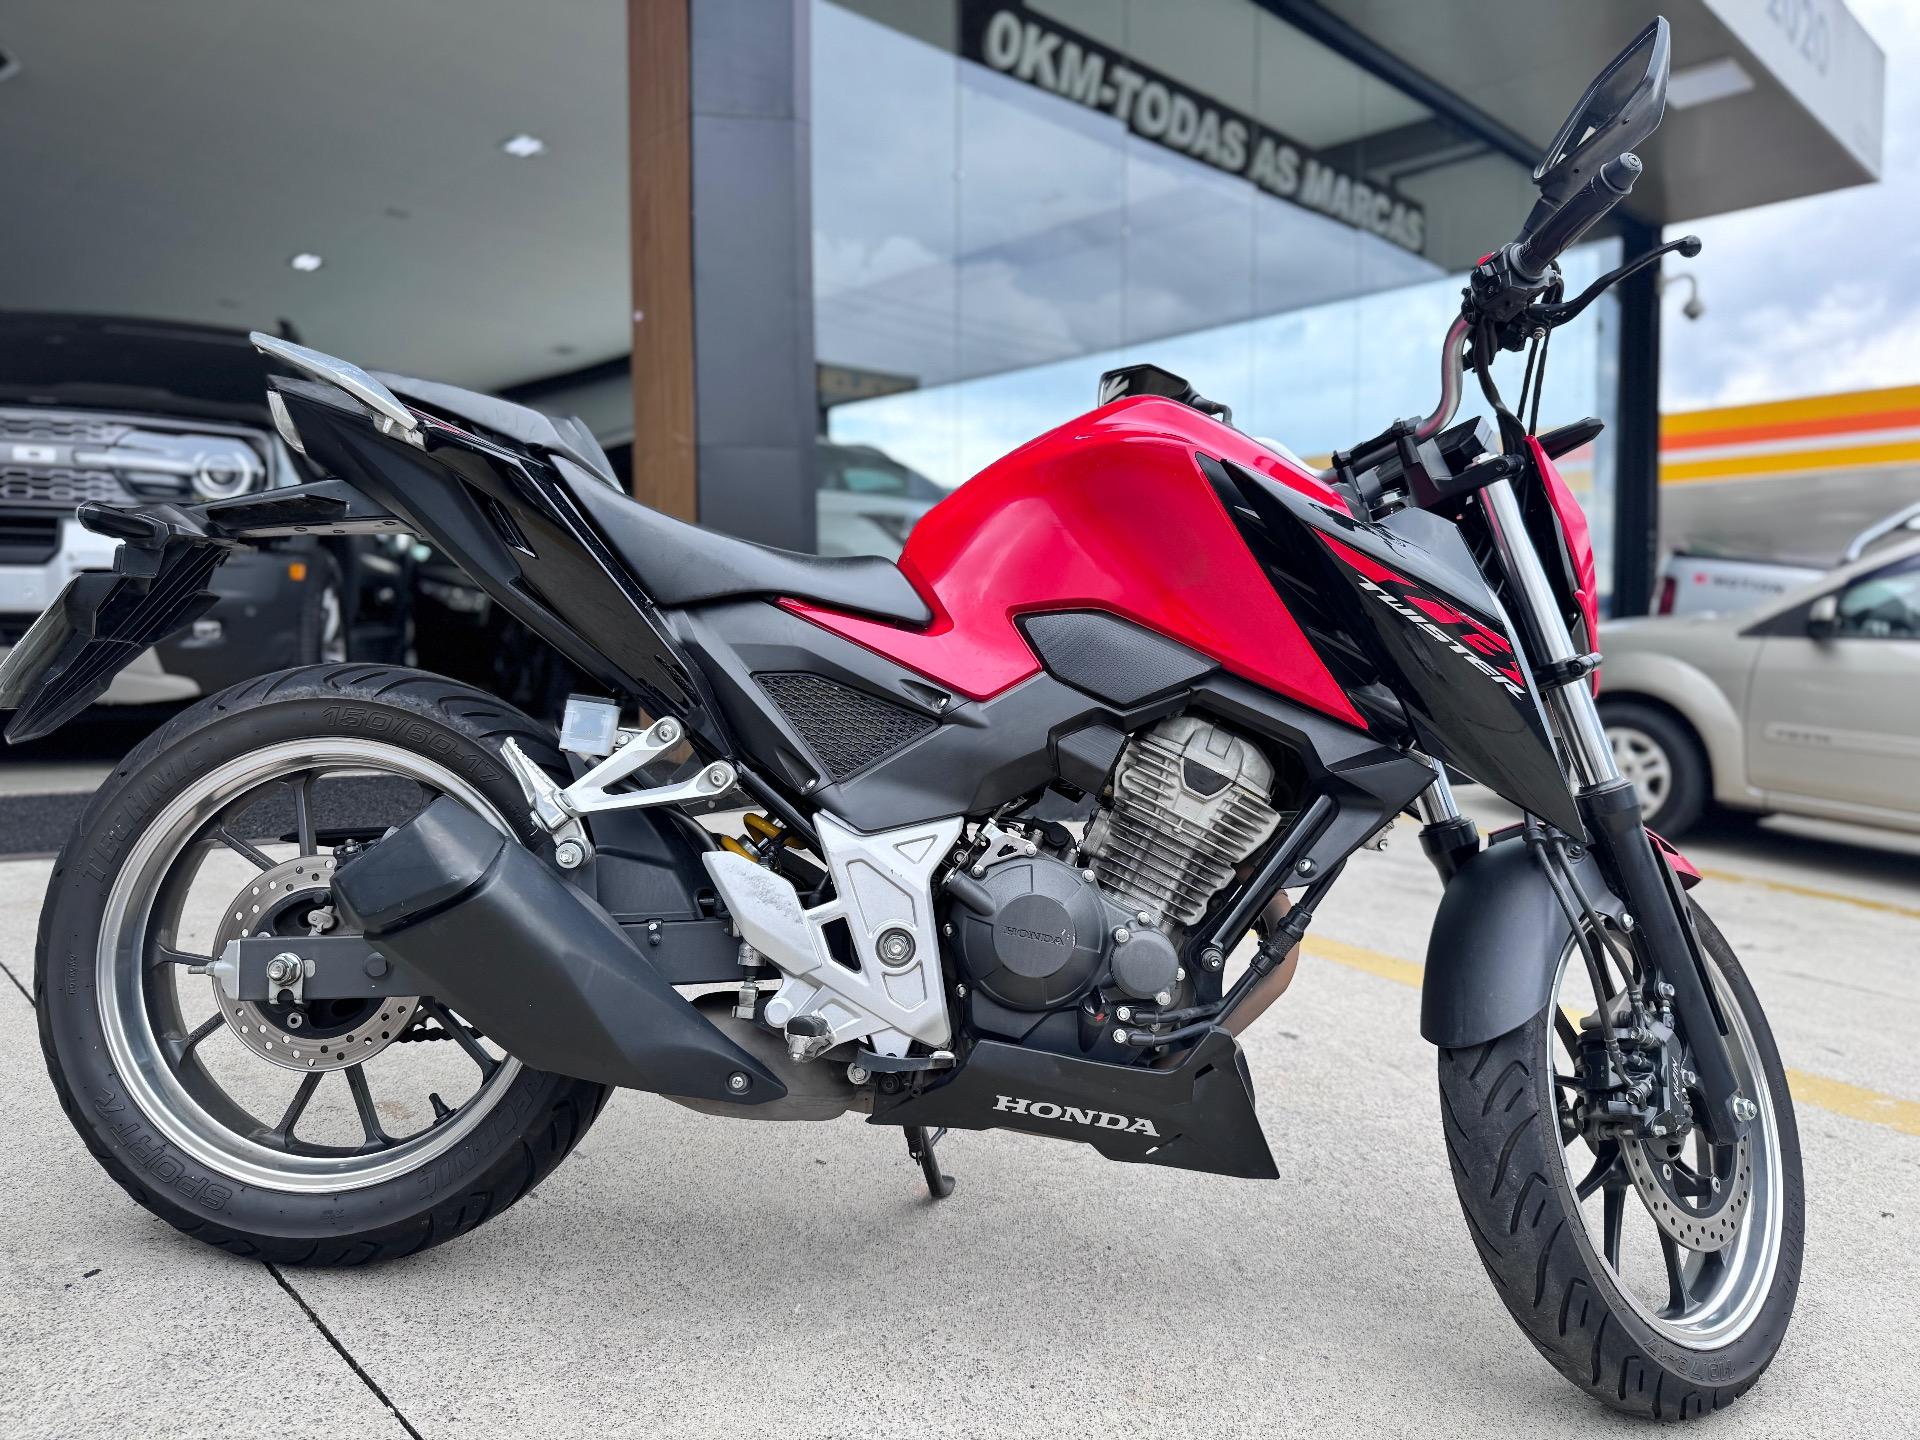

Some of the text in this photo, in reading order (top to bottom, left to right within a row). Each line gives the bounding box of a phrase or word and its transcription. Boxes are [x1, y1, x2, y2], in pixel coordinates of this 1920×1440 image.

[1250, 138, 1299, 197] AS
[1304, 160, 1425, 252] MARCAS
[1357, 574, 1526, 701] TWISTER
[322, 706, 503, 783] 150/60-17
[1003, 925, 1065, 946] HONDA
[992, 1094, 1161, 1138] HONDA
[110, 1123, 233, 1210] SPORT
